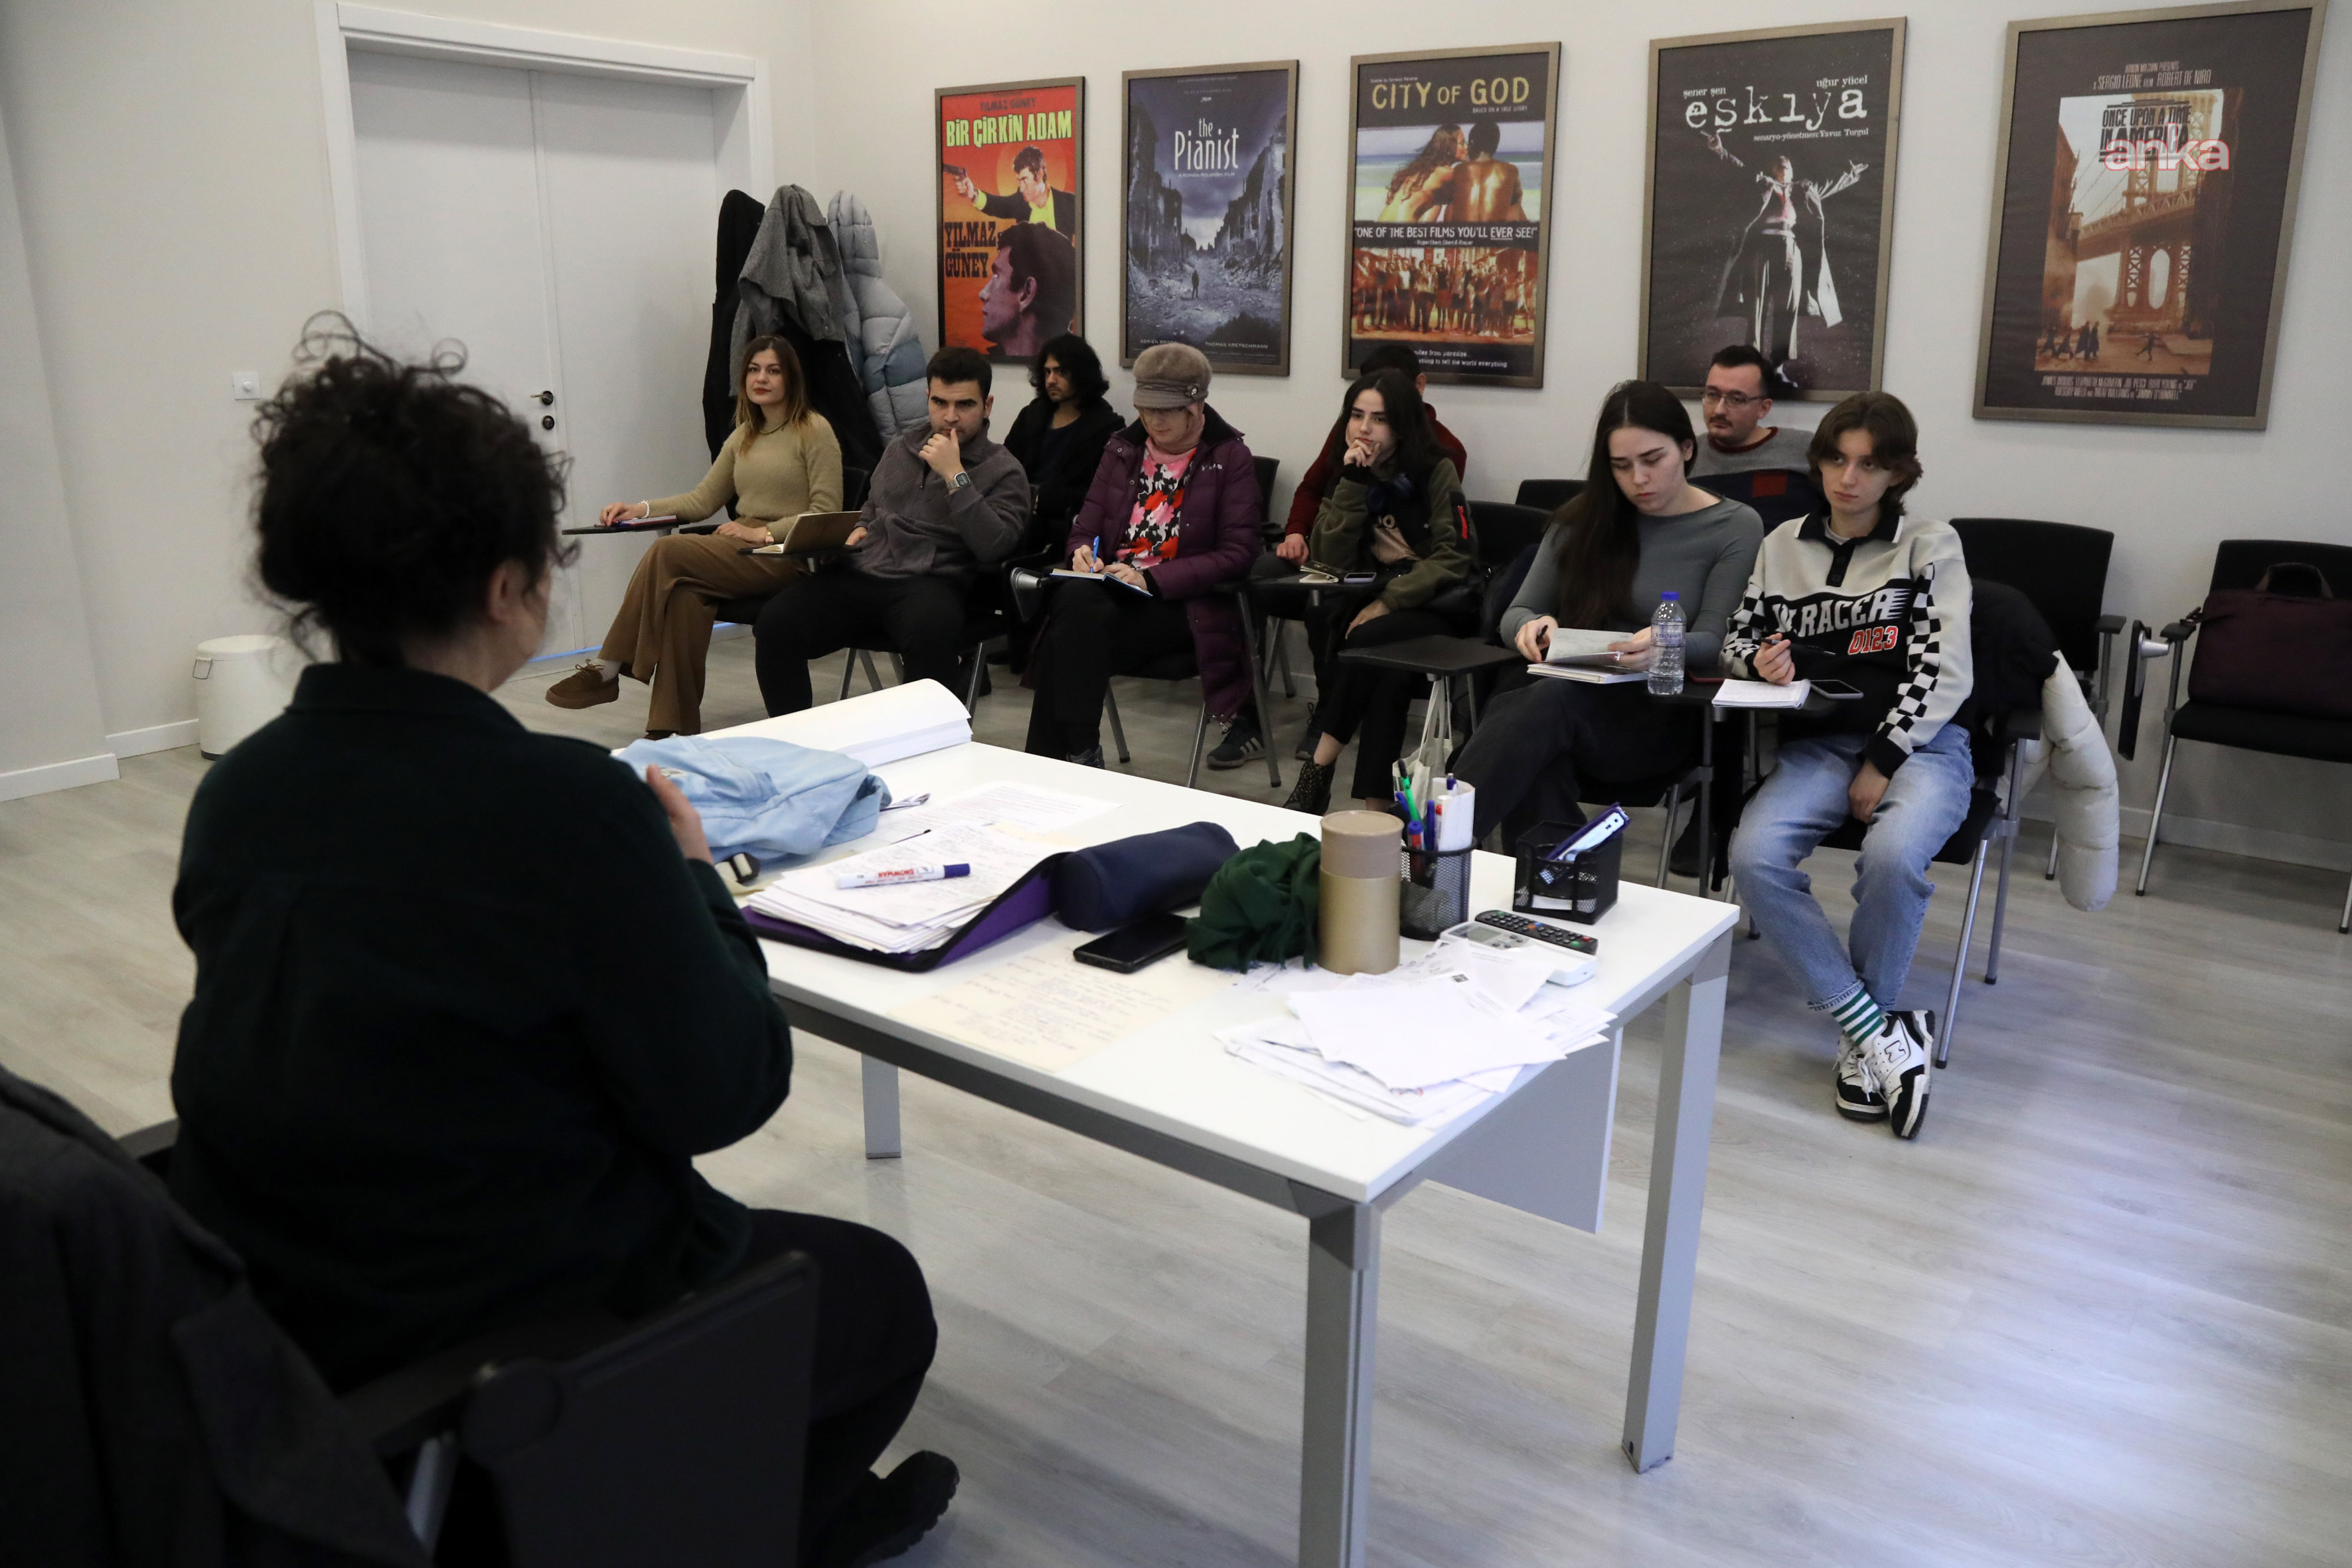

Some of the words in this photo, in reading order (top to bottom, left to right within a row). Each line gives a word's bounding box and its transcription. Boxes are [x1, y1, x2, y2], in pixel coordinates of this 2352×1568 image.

[1372, 82, 1431, 109] CITY
[1437, 86, 1461, 105] OF
[1470, 76, 1529, 105] GOD
[1684, 88, 1708, 99] şener
[1710, 87, 1726, 97] şen
[1816, 78, 1839, 89] uğur
[1842, 74, 1868, 88] yücel
[980, 101, 1008, 112] YILMAZ
[2102, 109, 2128, 127] ONCE
[2130, 108, 2156, 125] UPON
[2157, 108, 2165, 125] A
[2168, 106, 2191, 124] TIME
[1026, 110, 1072, 141] ADAM
[1199, 118, 1214, 137] the
[1174, 128, 1239, 170] Pianist
[945, 222, 996, 248] YILMAZ
[1375, 226, 1387, 238] OF
[1389, 226, 1405, 238] THE
[1407, 226, 1427, 238] BEST
[1430, 226, 1455, 238] FILMS
[1457, 226, 1488, 238] YOU'LL
[1490, 226, 1514, 238] EVER
[945, 248, 988, 277] GÜNEY
[1848, 625, 1899, 655] 0123
